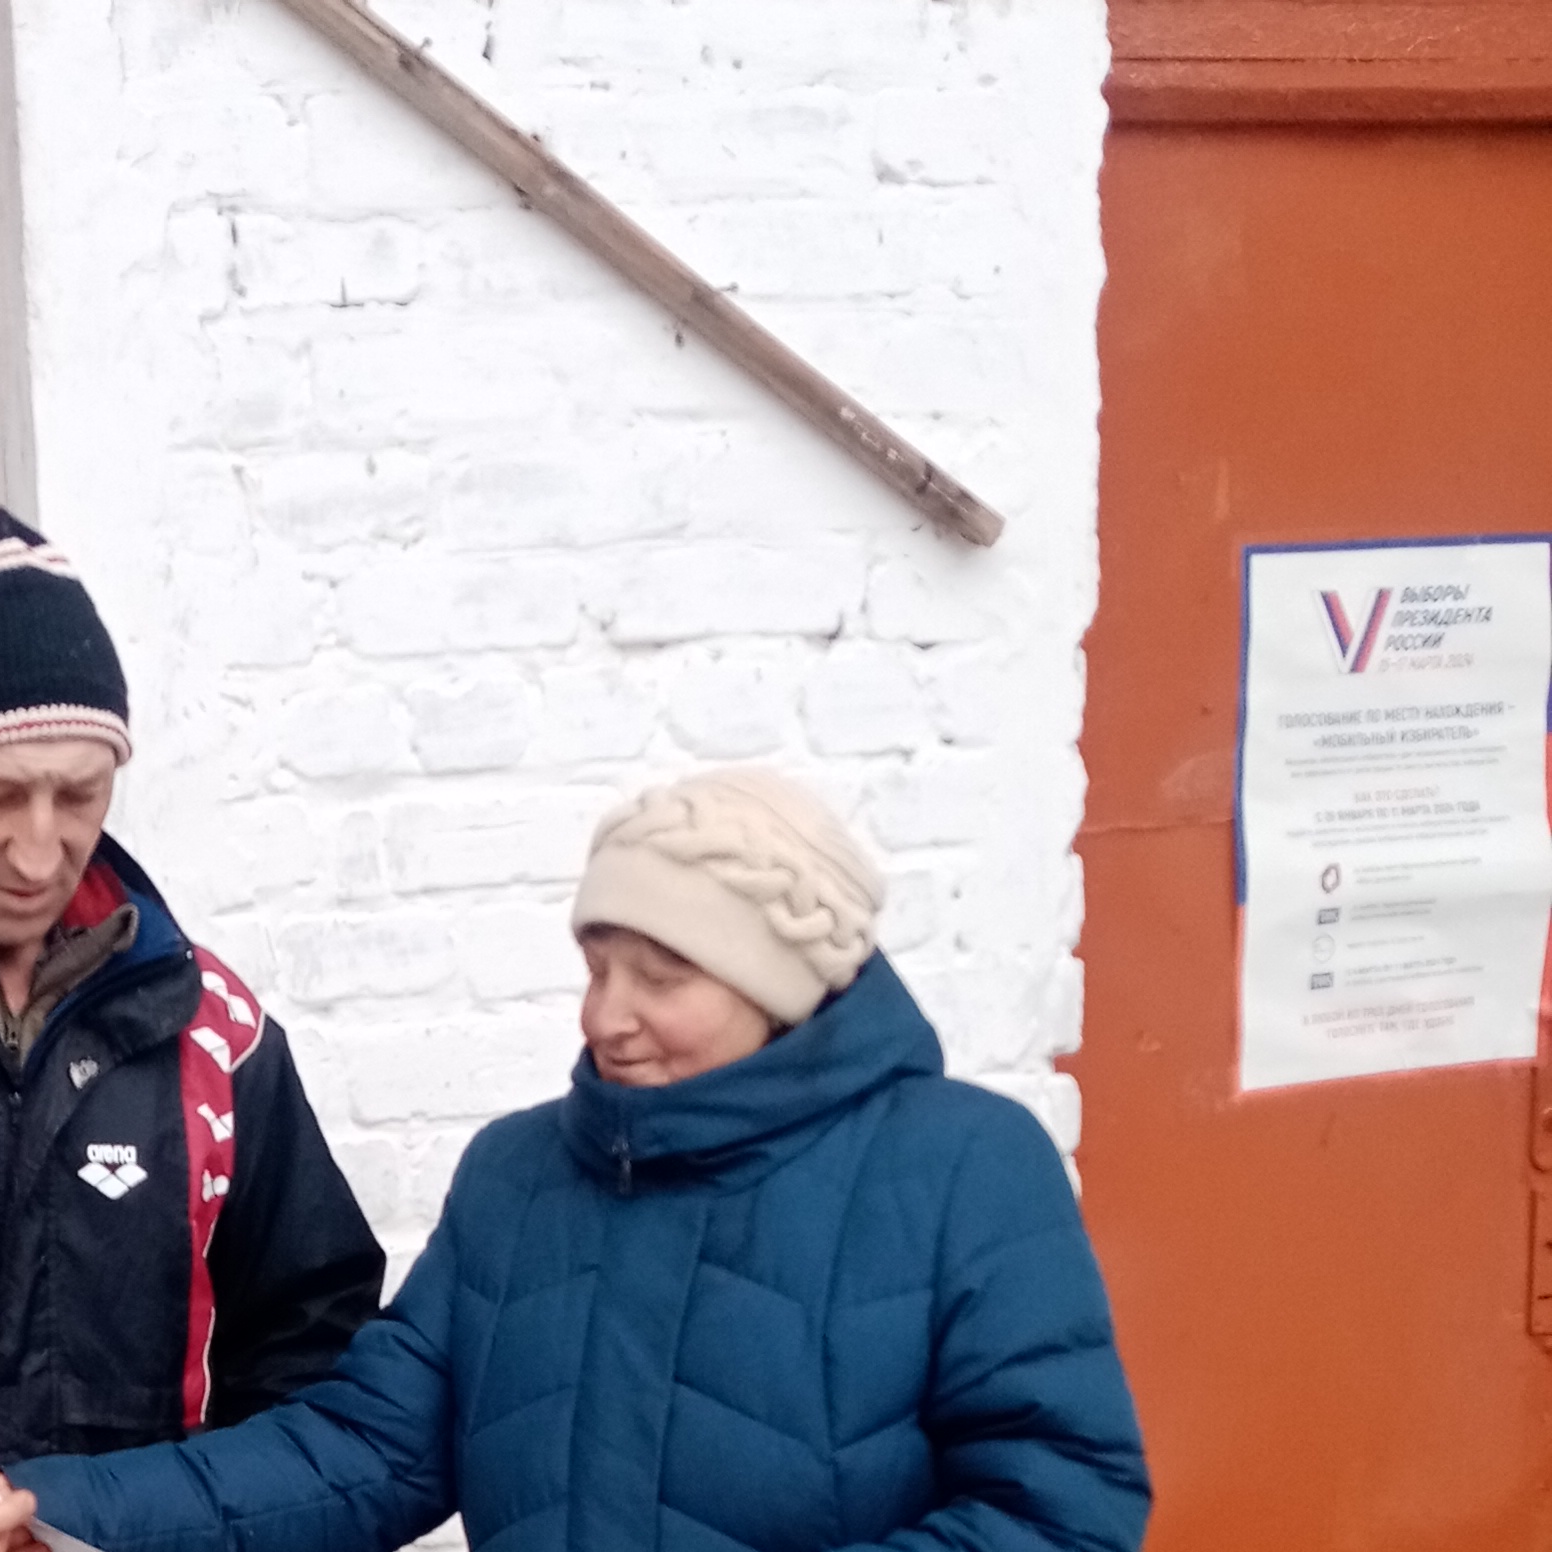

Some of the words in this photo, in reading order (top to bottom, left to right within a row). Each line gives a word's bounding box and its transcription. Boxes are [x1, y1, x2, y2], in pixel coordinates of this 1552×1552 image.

[1400, 584, 1471, 604] ВЫБОРЫ
[1390, 606, 1494, 628] ПРЕЗИДЕНТА
[1383, 632, 1446, 652] РОССИИ
[86, 1143, 138, 1165] arena
